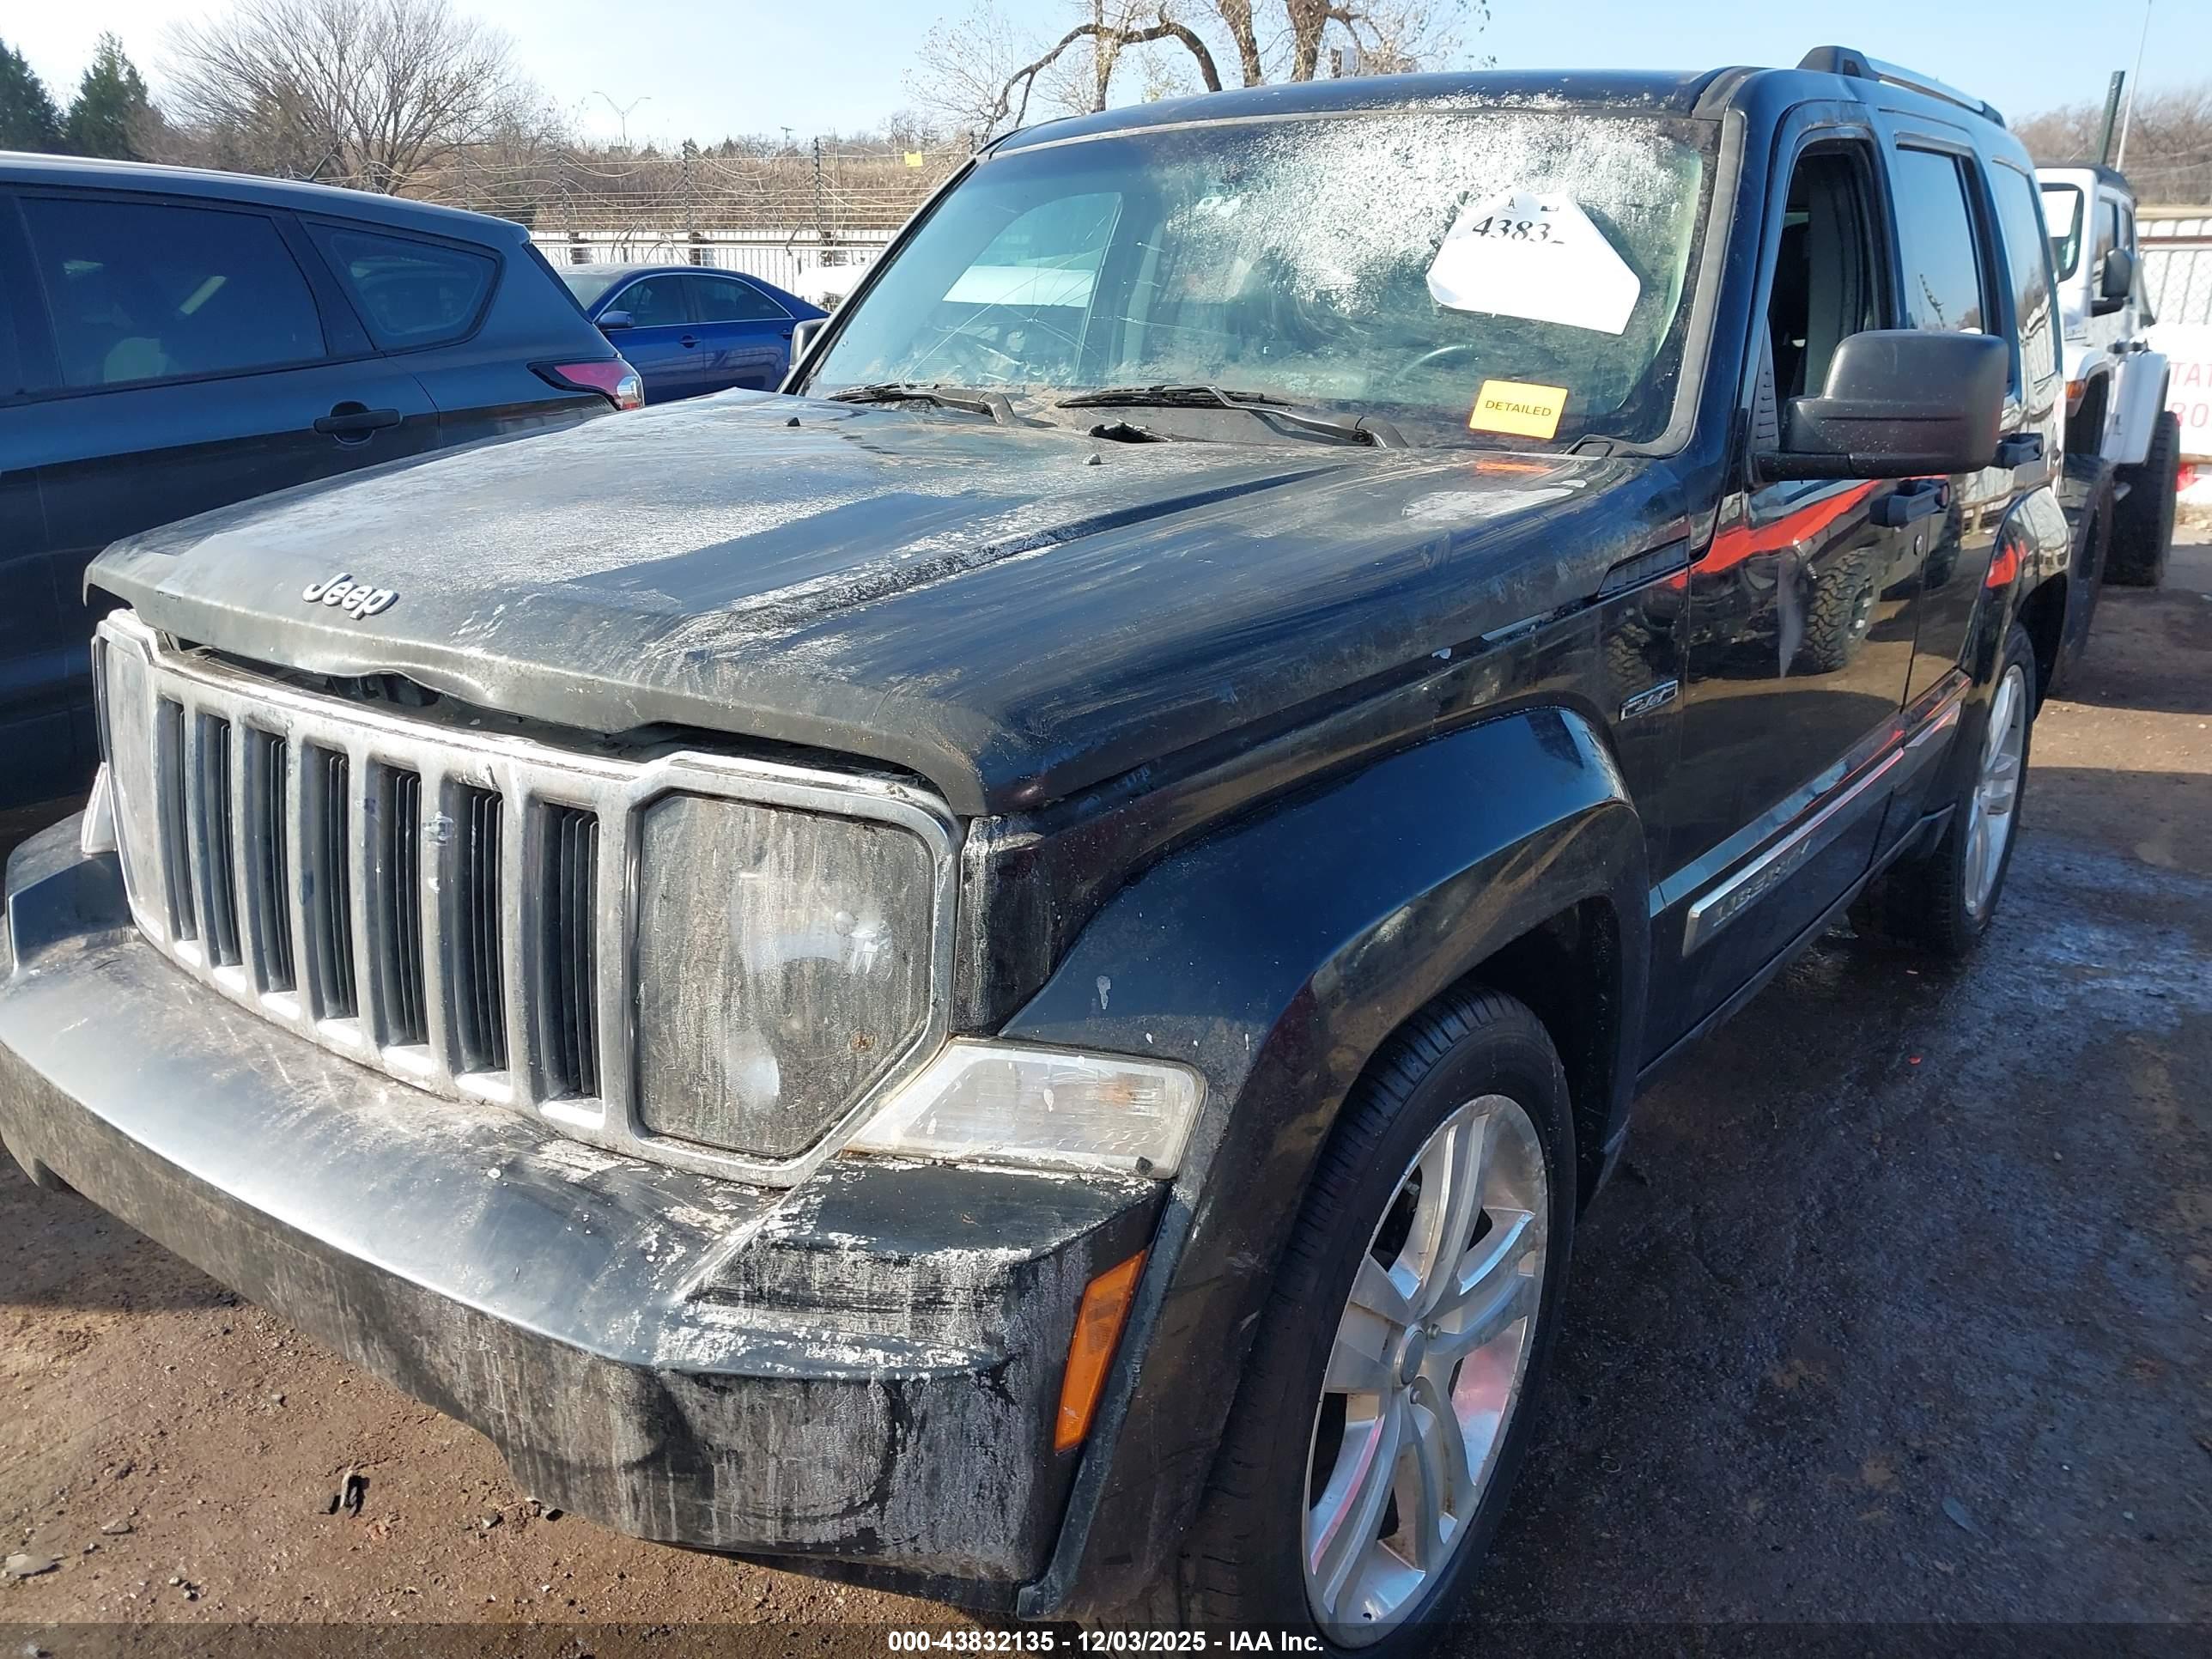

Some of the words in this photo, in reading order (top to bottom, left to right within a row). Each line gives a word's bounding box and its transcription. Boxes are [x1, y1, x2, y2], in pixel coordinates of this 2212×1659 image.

[1472, 216, 1565, 245] 4383
[1485, 400, 1552, 416] DETAILED
[302, 572, 399, 621] Jeep
